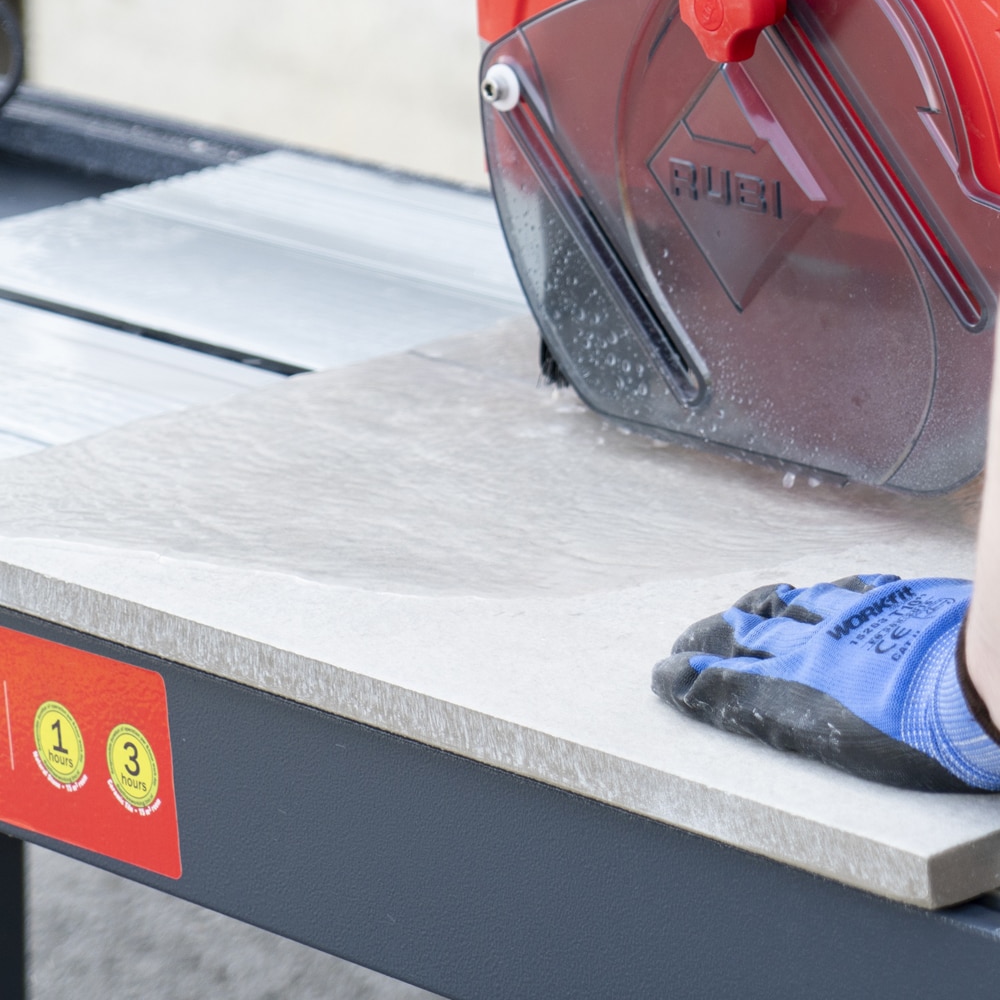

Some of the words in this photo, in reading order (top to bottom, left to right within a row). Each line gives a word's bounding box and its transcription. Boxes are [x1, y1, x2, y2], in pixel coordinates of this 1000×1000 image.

[669, 157, 783, 220] RUBI
[875, 625, 912, 654] CE
[51, 719, 69, 755] 1
[48, 749, 74, 769] hours
[123, 741, 141, 777] 3
[121, 772, 147, 792] hours
